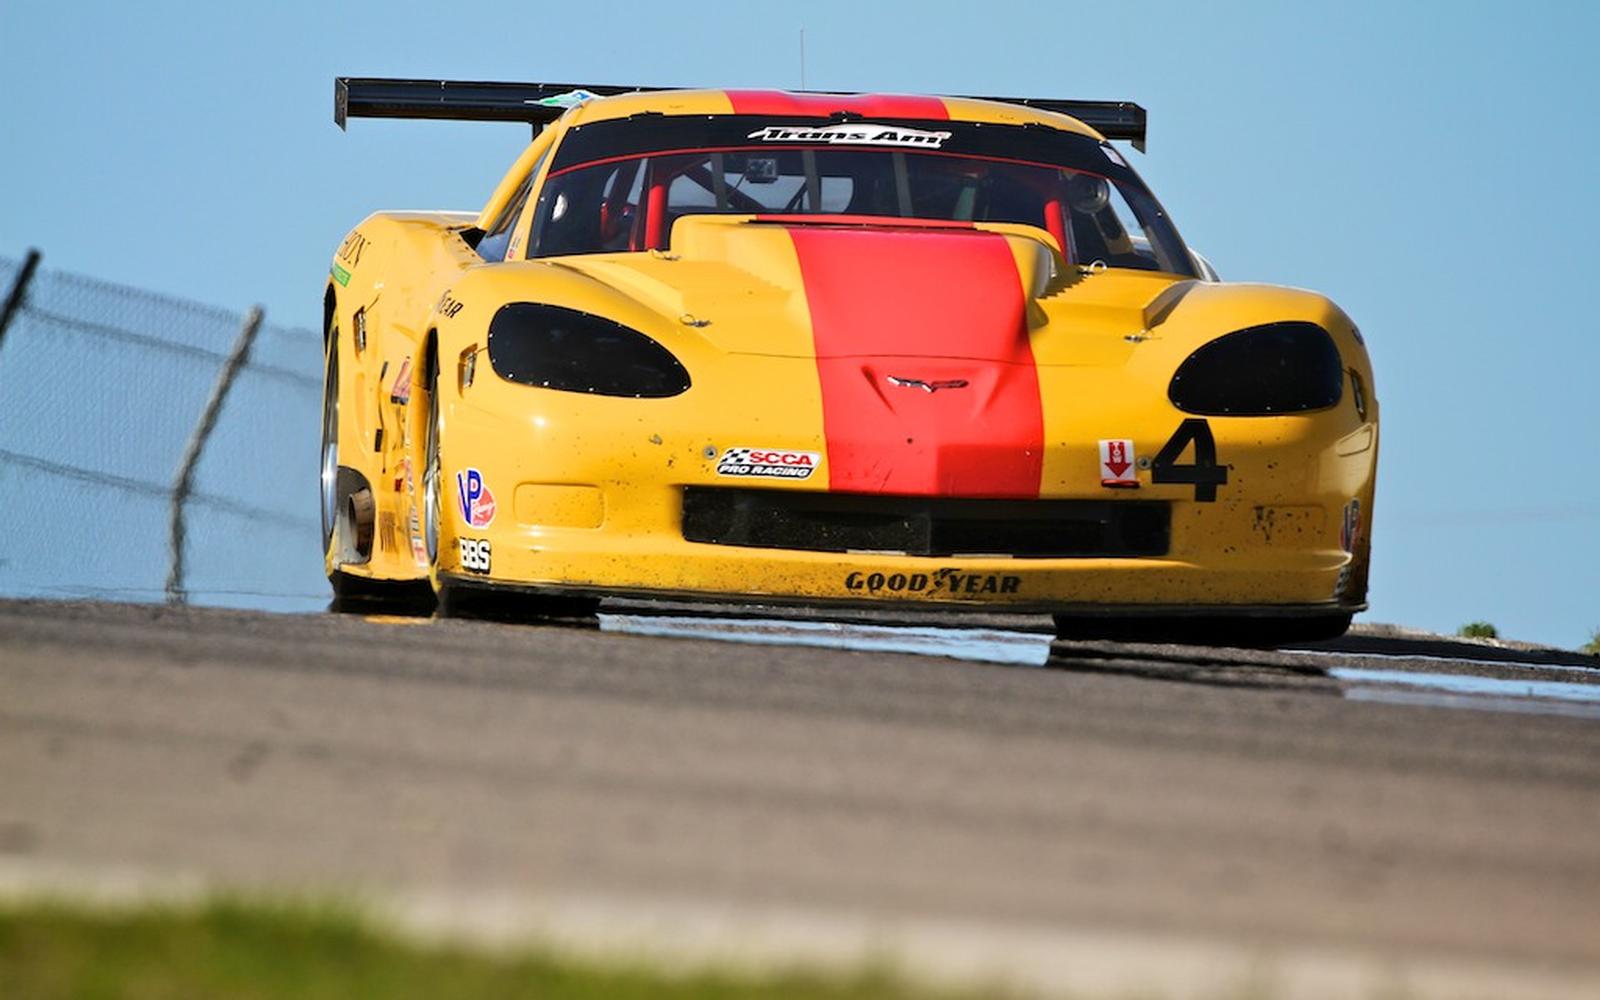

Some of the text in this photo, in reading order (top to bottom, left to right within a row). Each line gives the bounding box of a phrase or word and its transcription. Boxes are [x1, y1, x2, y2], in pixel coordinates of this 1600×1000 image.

[765, 127, 946, 146] Trans Am
[749, 451, 812, 466] SCCA
[1151, 418, 1228, 502] 4
[719, 465, 809, 477] PRO RACING
[457, 469, 482, 525] VP
[459, 537, 492, 574] BBS
[845, 571, 1021, 594] GOOD YEAR
